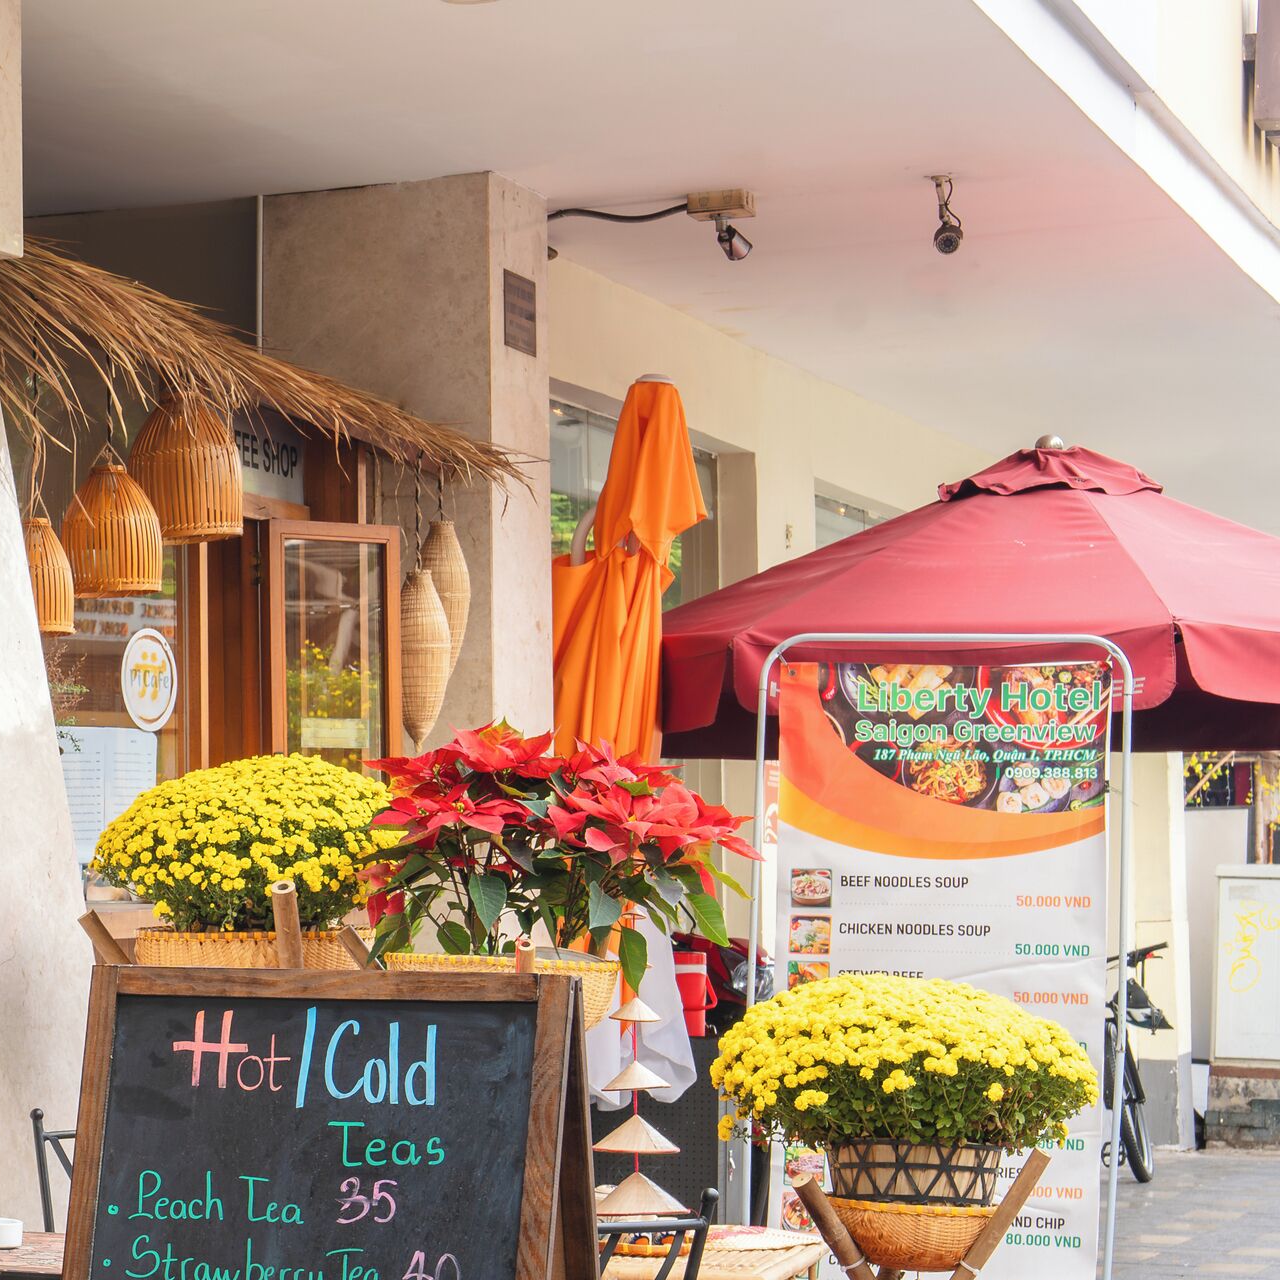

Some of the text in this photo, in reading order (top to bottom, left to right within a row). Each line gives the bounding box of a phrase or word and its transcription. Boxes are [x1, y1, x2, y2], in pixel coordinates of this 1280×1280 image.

[262, 438, 298, 479] SHOP
[857, 681, 991, 718] Liberty
[1001, 680, 1101, 713] Hotel
[854, 720, 1097, 747] Saigon Greenview
[873, 749, 896, 761] 187
[897, 749, 933, 763] Phạm
[1024, 749, 1040, 763] 1,
[1042, 749, 1097, 762] TP.HCM
[1005, 766, 1098, 780] 0909.388.813
[840, 875, 969, 889] BEEF NOODLES SOUP
[1015, 895, 1092, 908] 50.000 VND
[839, 922, 991, 937] CHICKEN NOODLES SOUP
[1014, 943, 1090, 957] 50.000 VND
[1013, 991, 1089, 1005] 50.000 VND
[327, 1120, 445, 1168] Teas
[128, 1169, 398, 1225] Peach Tea 35
[1056, 1186, 1083, 1200] VND
[1035, 1216, 1066, 1230] CHIP
[1005, 1232, 1082, 1249] 80.000 VND
